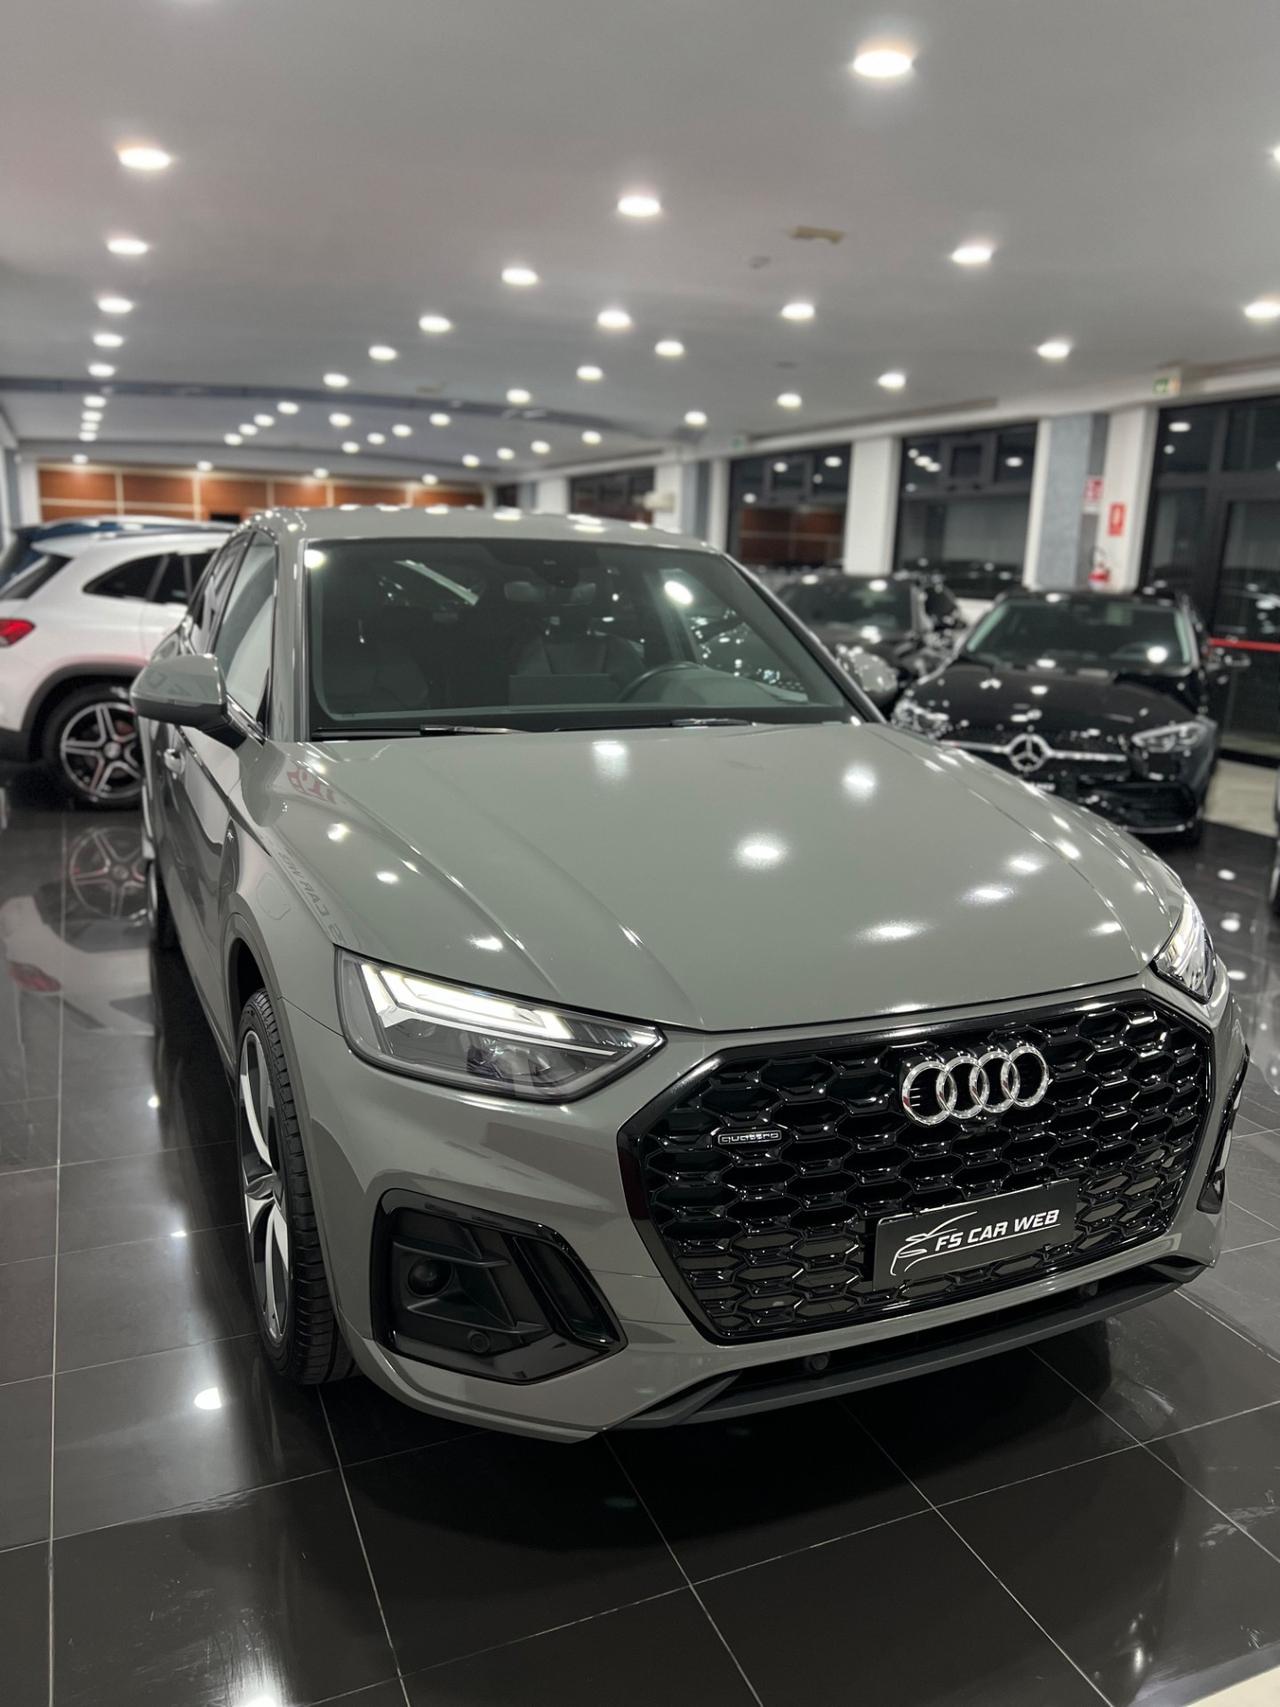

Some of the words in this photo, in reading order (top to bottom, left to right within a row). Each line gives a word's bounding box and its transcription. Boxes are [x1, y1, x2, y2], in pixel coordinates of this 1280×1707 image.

[721, 1132, 779, 1144] quattro
[935, 1232, 964, 1252] FS
[967, 1221, 1008, 1244] CAR
[1014, 1209, 1060, 1233] WEB
